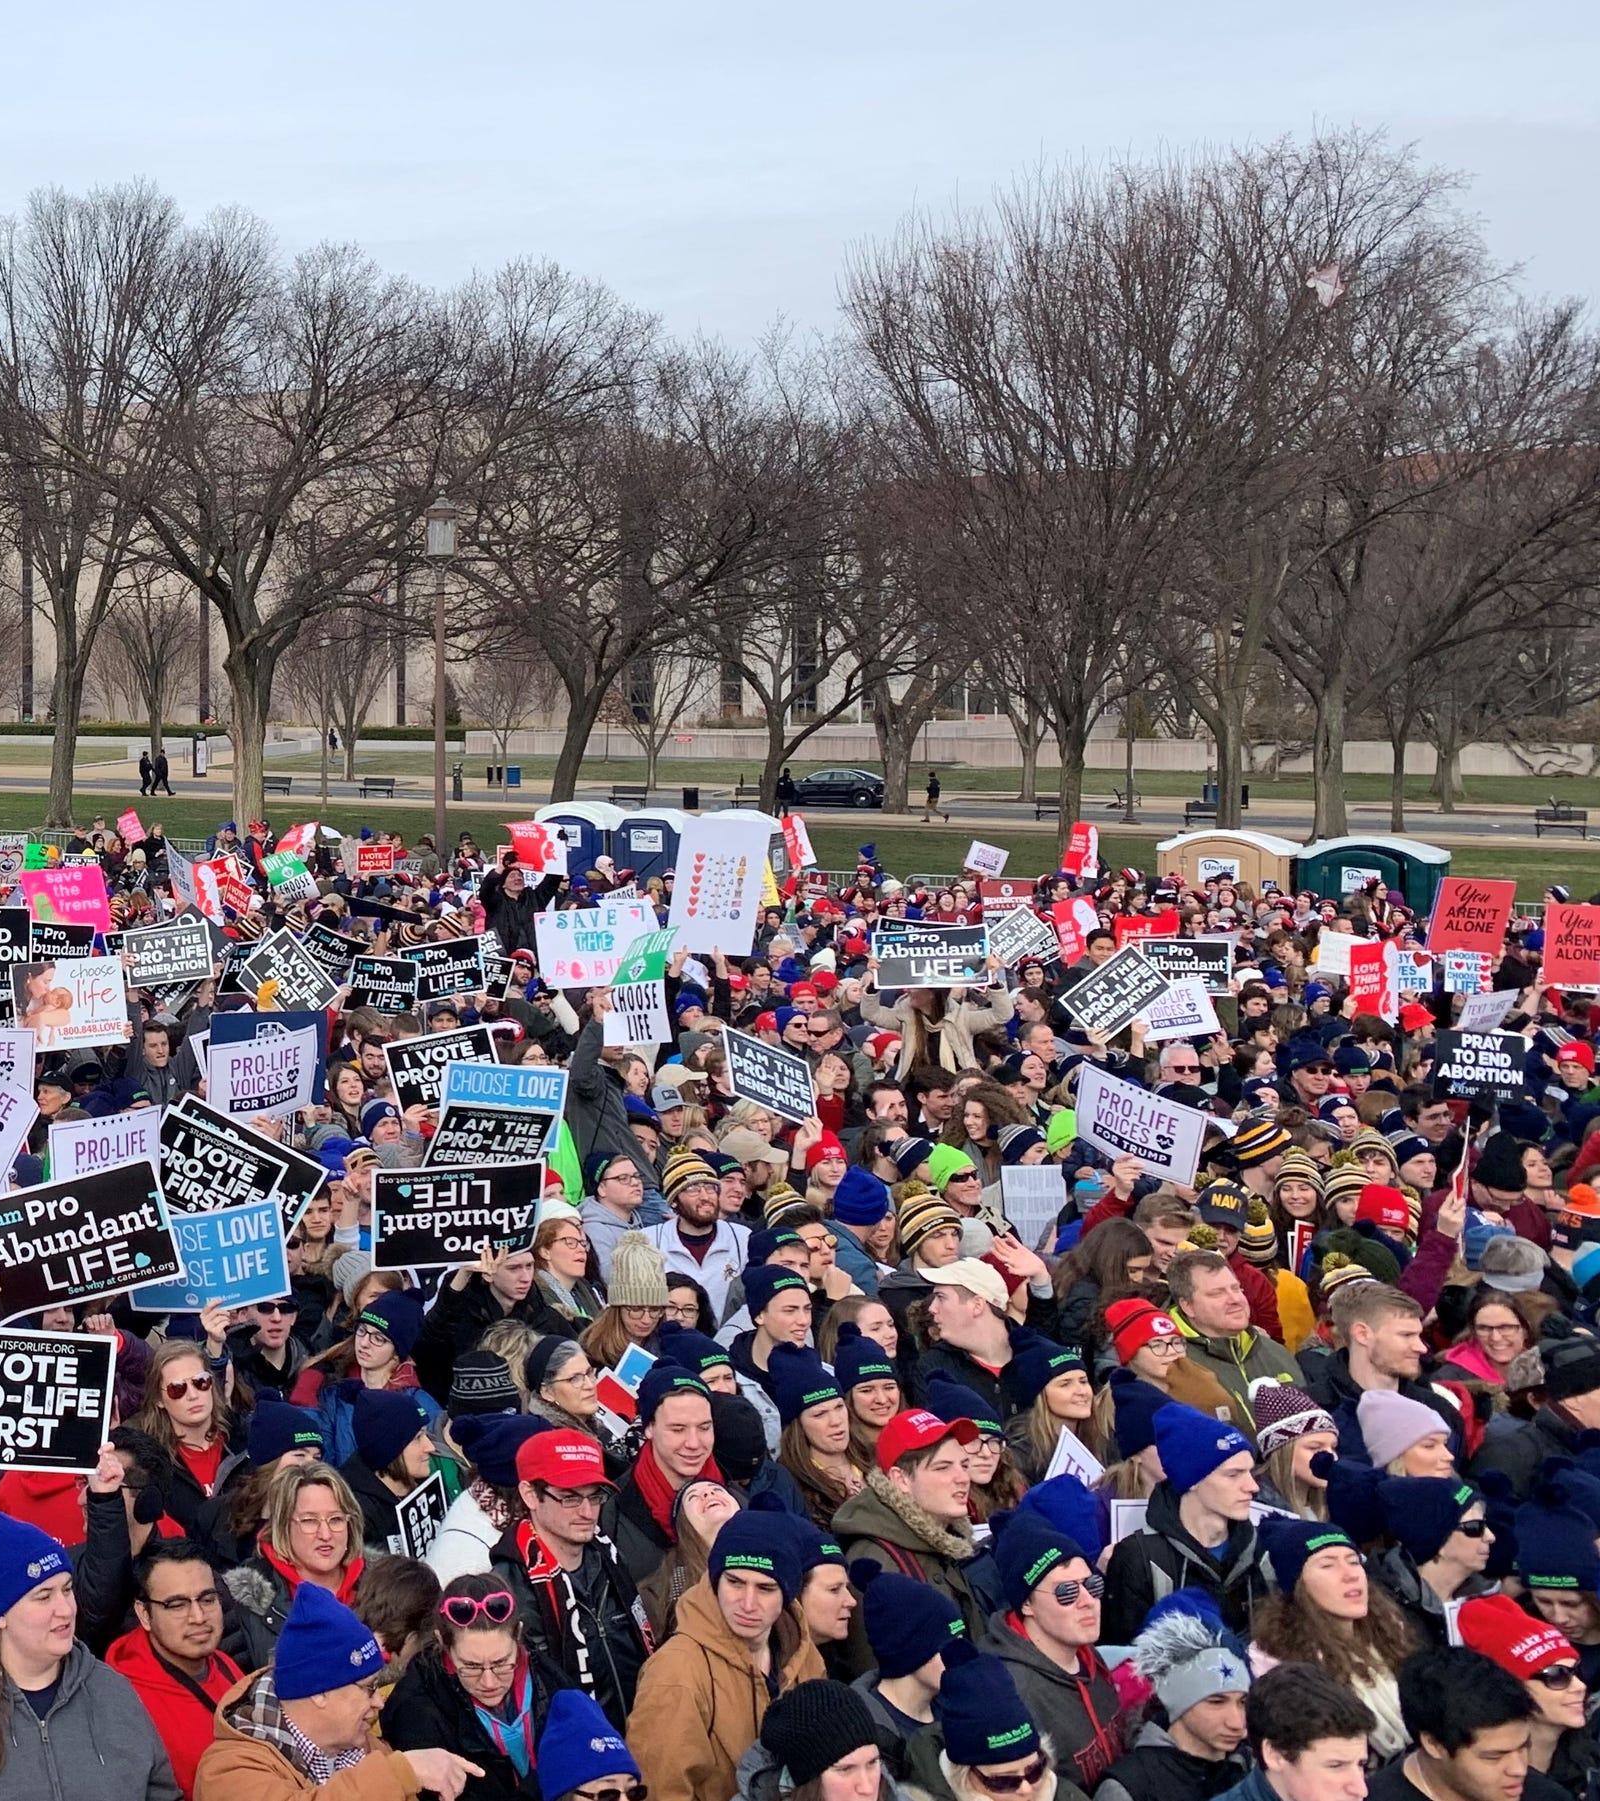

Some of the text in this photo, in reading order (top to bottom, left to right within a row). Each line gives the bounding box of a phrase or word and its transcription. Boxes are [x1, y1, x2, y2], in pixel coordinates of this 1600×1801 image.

[515, 830, 540, 839] BOTH
[360, 859, 390, 868] PRO-LIFE
[1203, 863, 1235, 873] United
[46, 870, 82, 883] save
[279, 876, 310, 895] CHOOSE
[53, 884, 81, 896] the
[983, 895, 1034, 905] BENEDICTINE
[1455, 882, 1491, 910] You
[556, 910, 617, 929] SAVE
[1446, 907, 1501, 919] AREN'T
[1444, 920, 1494, 934] ALONE
[132, 934, 200, 952] I AM THE
[574, 932, 614, 952] THE
[129, 944, 207, 964] PRO-LIFE
[1447, 951, 1480, 960] CHOOSE
[1555, 948, 1600, 961] ALONE
[69, 963, 117, 978] choose
[133, 959, 206, 978] GENERATION
[910, 959, 964, 978] LIFE
[1354, 962, 1380, 975] LOVE
[1446, 972, 1480, 980] CHOOSE
[1075, 956, 1139, 1010] I AM THE
[76, 978, 118, 1017] life
[1079, 967, 1155, 1023] PRO-LIFE
[1093, 976, 1162, 1030] GENERATION
[57, 1022, 122, 1037] 1.800.848.LOVE
[628, 1011, 653, 1041] LIFE
[1152, 1015, 1201, 1028] FOR TRUMP
[1461, 1033, 1504, 1049] PRAY
[230, 1046, 301, 1078] PRO-LIFE
[402, 1041, 476, 1068] I VOTE
[733, 1041, 804, 1083] I AM THE
[1452, 1048, 1512, 1067] TO END
[230, 1071, 283, 1096] VOICES
[732, 1053, 812, 1100] PRO-LIFE
[1437, 1062, 1524, 1085] ABORTION
[450, 1072, 560, 1101] CHOOSE LOVE
[735, 1073, 812, 1113] GENERATION
[1098, 1086, 1180, 1136] PRO-LIFE
[448, 1117, 542, 1136] I AM THE
[1095, 1103, 1150, 1142] VOICES
[75, 1129, 147, 1166] PRO-LIFE
[436, 1131, 542, 1154] PRO-LIFE
[1095, 1125, 1168, 1164] FOR TRUMP
[173, 1132, 259, 1181] I VOTE
[413, 1180, 491, 1209] LIFE
[24, 1196, 79, 1227] Pro
[217, 1210, 275, 1248] LOVE
[224, 1248, 270, 1284] LIFE
[67, 1261, 175, 1295] See why at care-net.org
